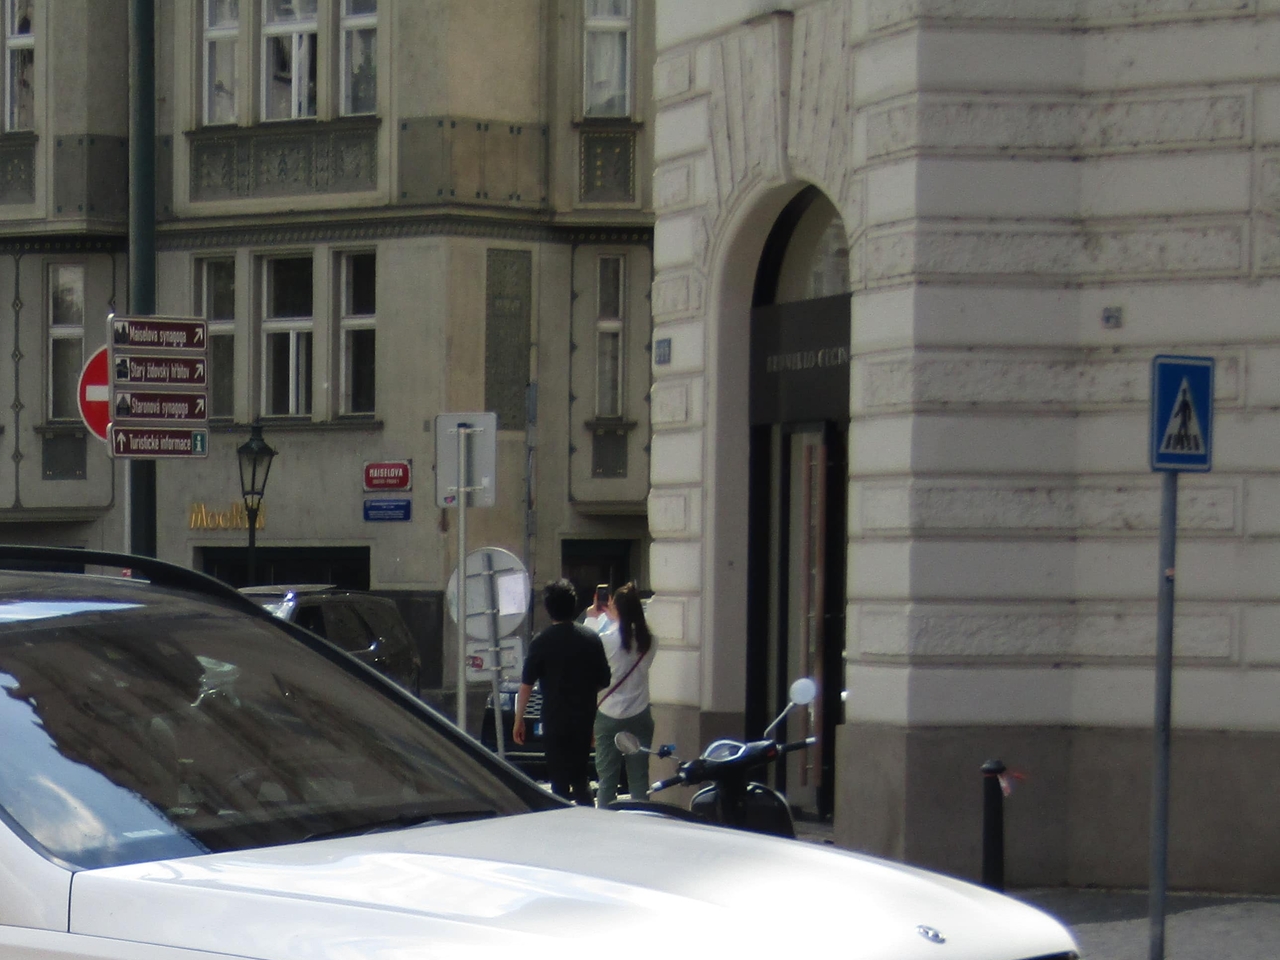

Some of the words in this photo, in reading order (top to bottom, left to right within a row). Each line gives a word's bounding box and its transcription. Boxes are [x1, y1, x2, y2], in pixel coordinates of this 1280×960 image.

[130, 325, 158, 342] Maiselova
[159, 330, 187, 347] synagoga
[131, 361, 145, 381] Starý
[147, 362, 169, 382] židovský
[132, 397, 160, 414] Staronová
[161, 402, 188, 418] synagoga
[128, 434, 159, 450] Turistické
[160, 434, 191, 450] informace
[369, 468, 403, 477] MAISELOVA
